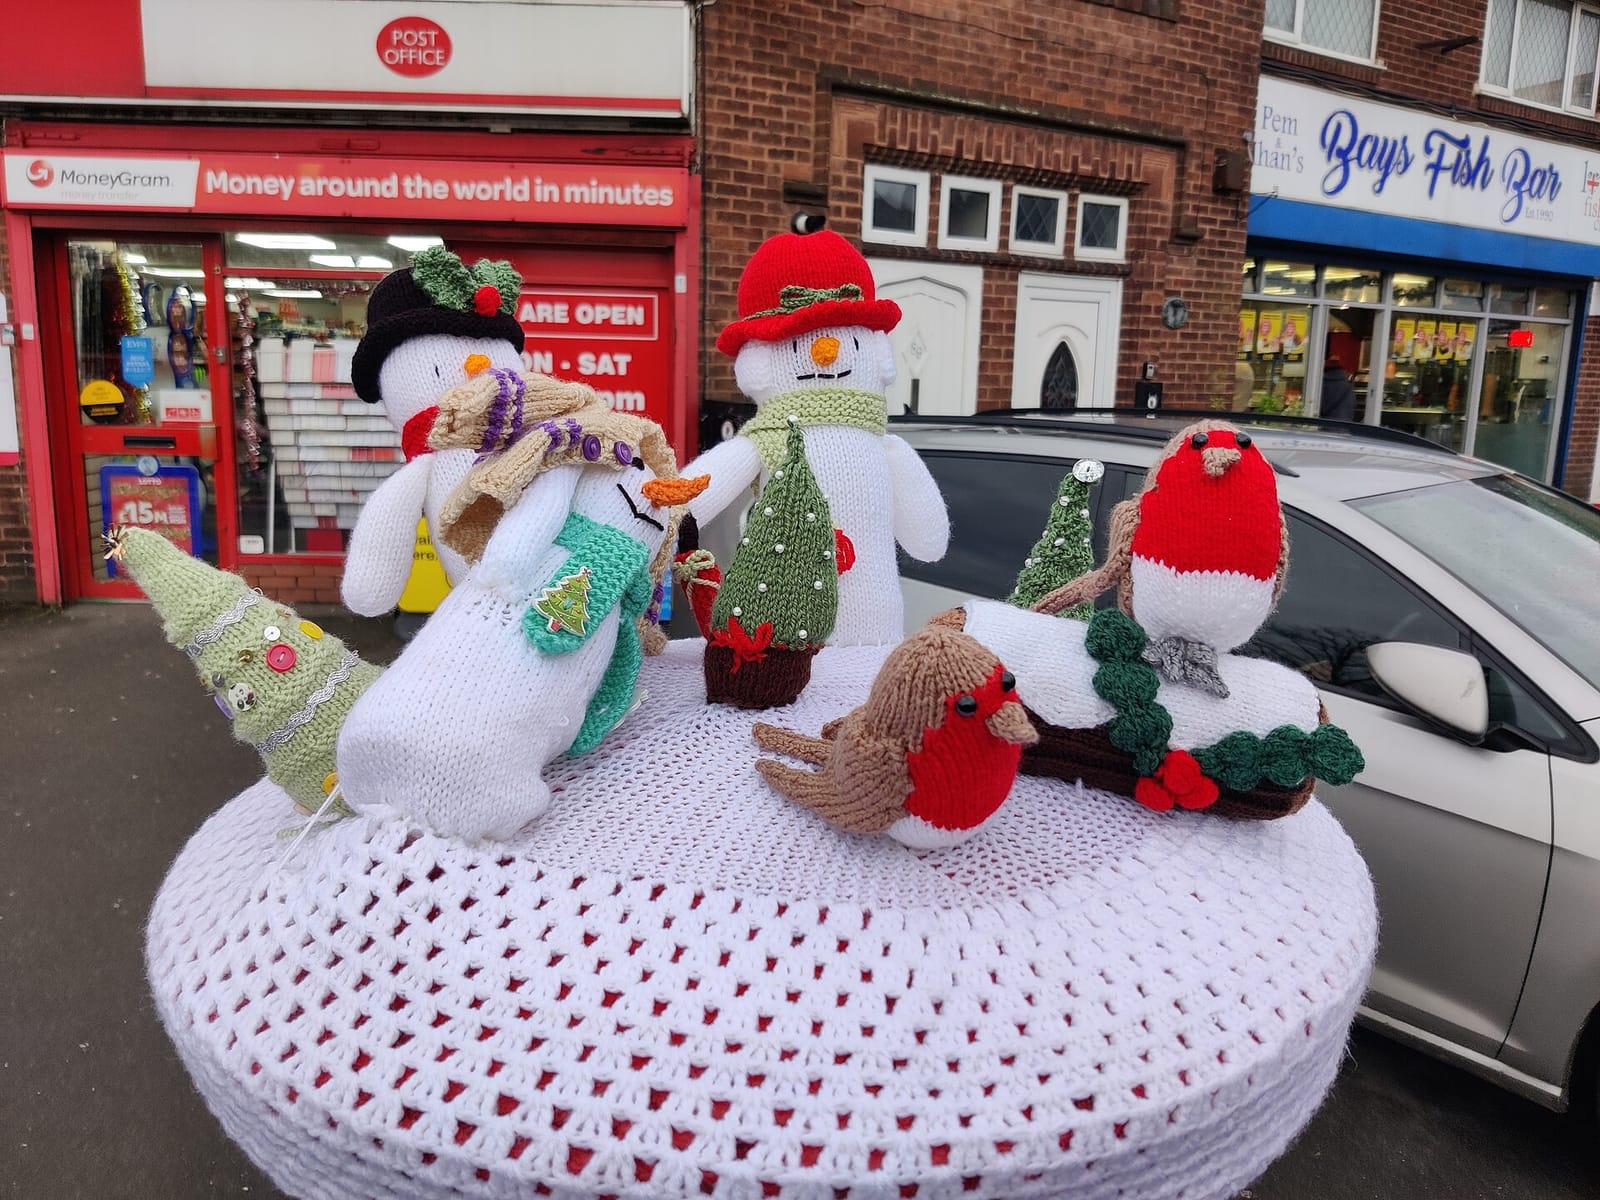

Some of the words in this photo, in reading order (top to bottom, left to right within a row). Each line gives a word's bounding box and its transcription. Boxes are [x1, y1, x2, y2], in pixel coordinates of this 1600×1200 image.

[391, 29, 439, 47] POST
[384, 48, 445, 66] OFFICE
[1261, 105, 1298, 137] Pem
[1320, 110, 1415, 196] Bays
[1424, 128, 1495, 200] Fish
[1501, 147, 1562, 223] Bar
[205, 169, 295, 200] Money
[299, 172, 398, 198] around
[403, 173, 449, 200] the
[453, 176, 530, 203] world
[534, 175, 560, 203] in
[564, 177, 674, 206] minutes
[519, 301, 570, 323] ARE
[575, 304, 645, 326] OPEN
[577, 352, 632, 376] SAT
